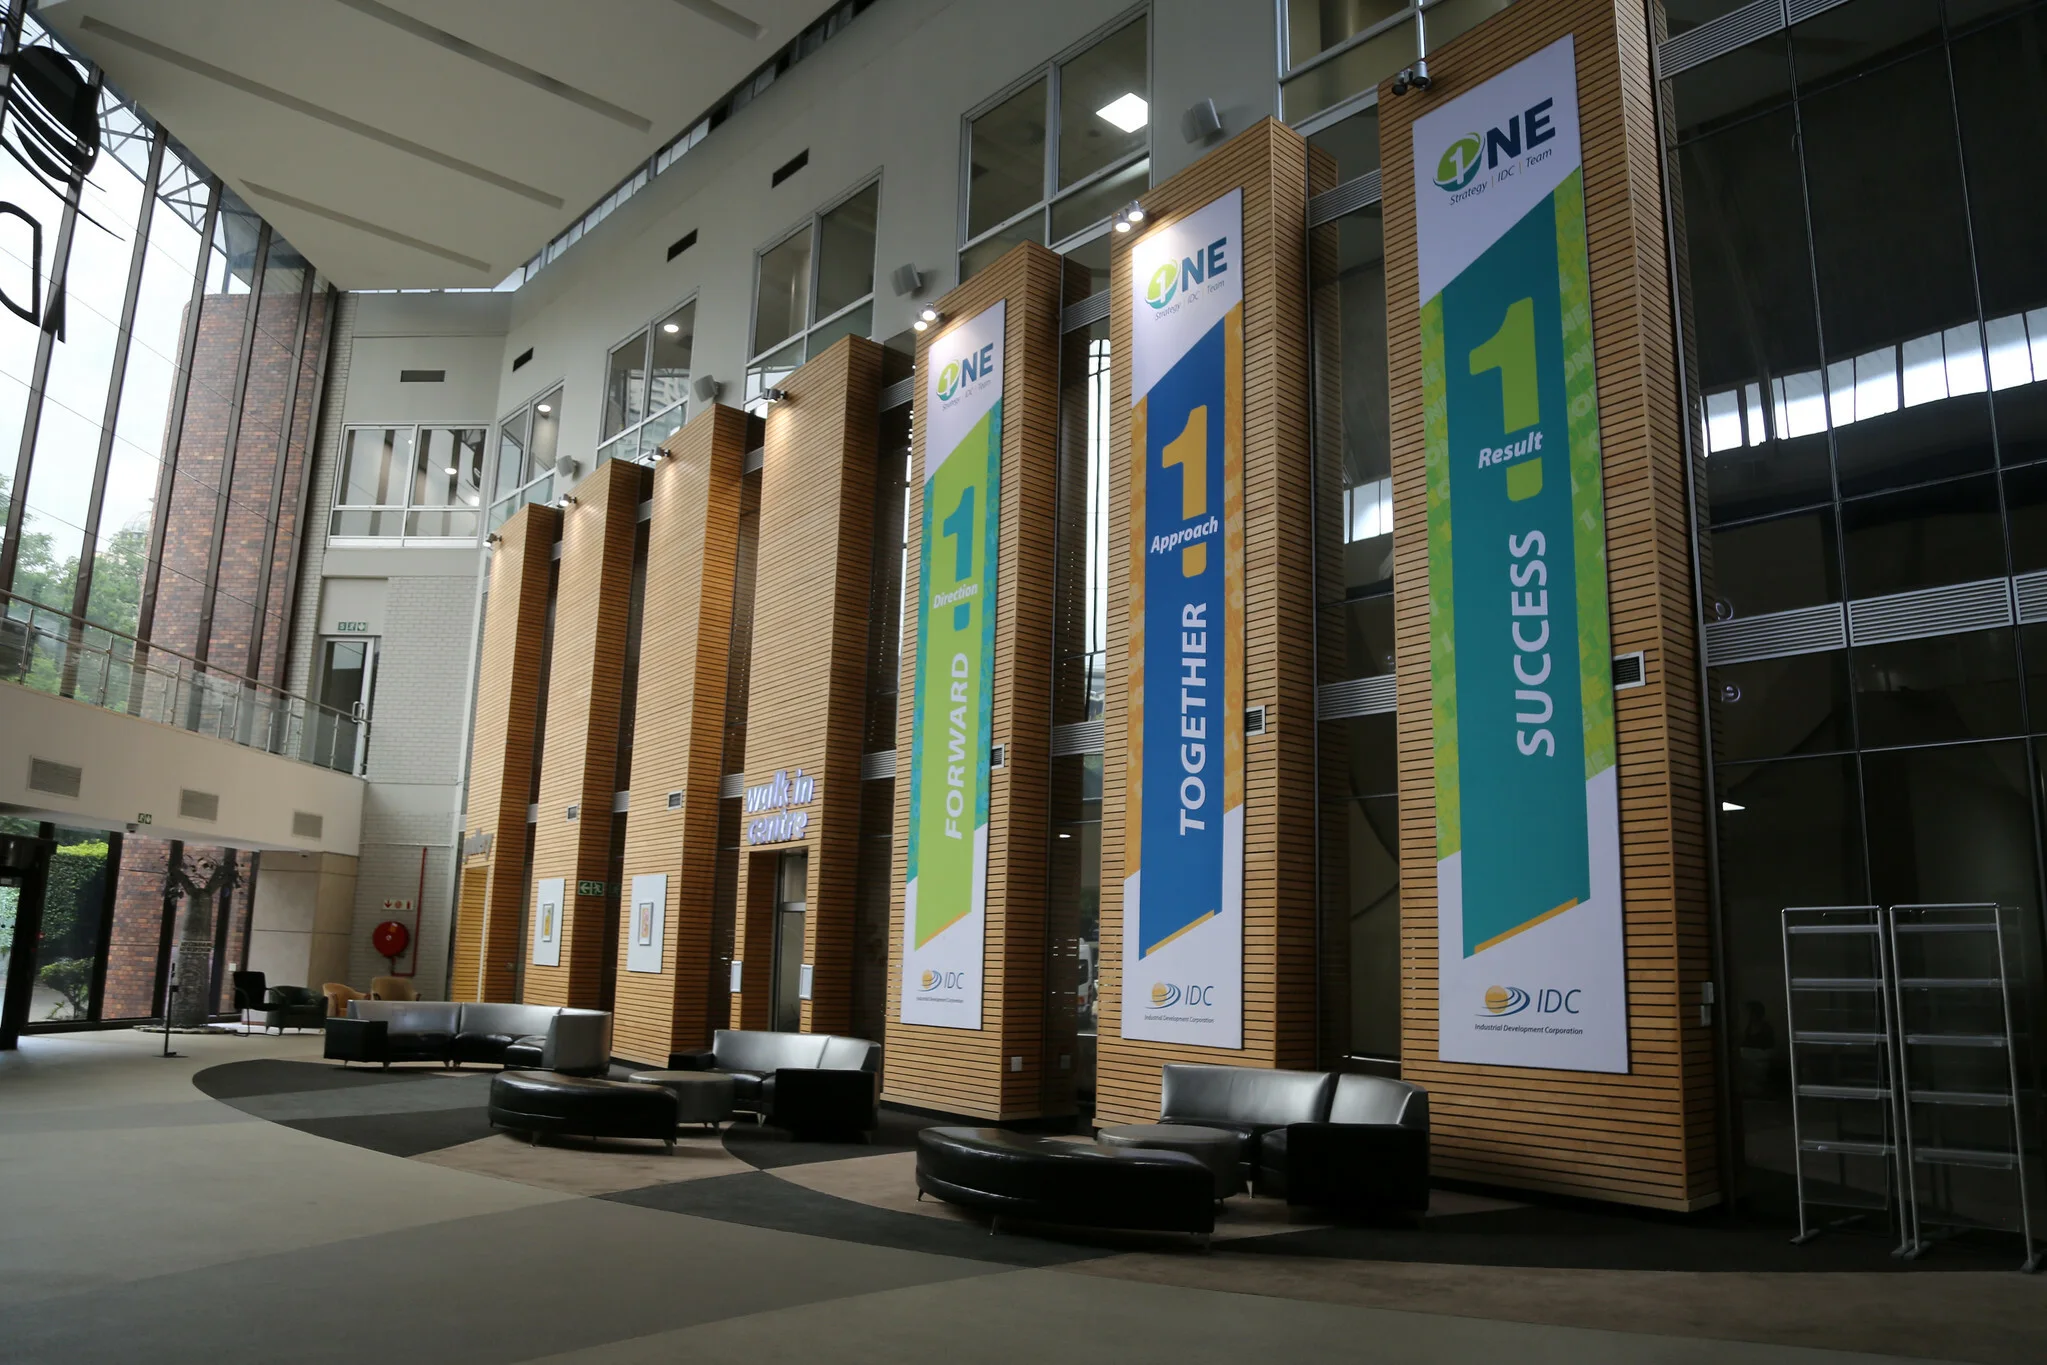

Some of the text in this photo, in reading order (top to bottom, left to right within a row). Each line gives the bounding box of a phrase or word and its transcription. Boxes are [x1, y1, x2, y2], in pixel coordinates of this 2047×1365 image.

[1450, 149, 1553, 206] Strategy IDC Team
[1478, 431, 1543, 469] Result
[1150, 516, 1219, 554] Approach
[933, 584, 979, 609] Direction
[1508, 530, 1555, 757] SUCCESS
[1180, 602, 1207, 836] TOGETHER
[945, 653, 969, 840] FORWARD
[746, 768, 814, 813] walk in
[747, 808, 808, 845] centre
[944, 972, 964, 989] IDC
[1185, 985, 1214, 1006] IDC
[1537, 989, 1582, 1014] IDC
[1474, 1023, 1583, 1035] Industrial Development Corporation
